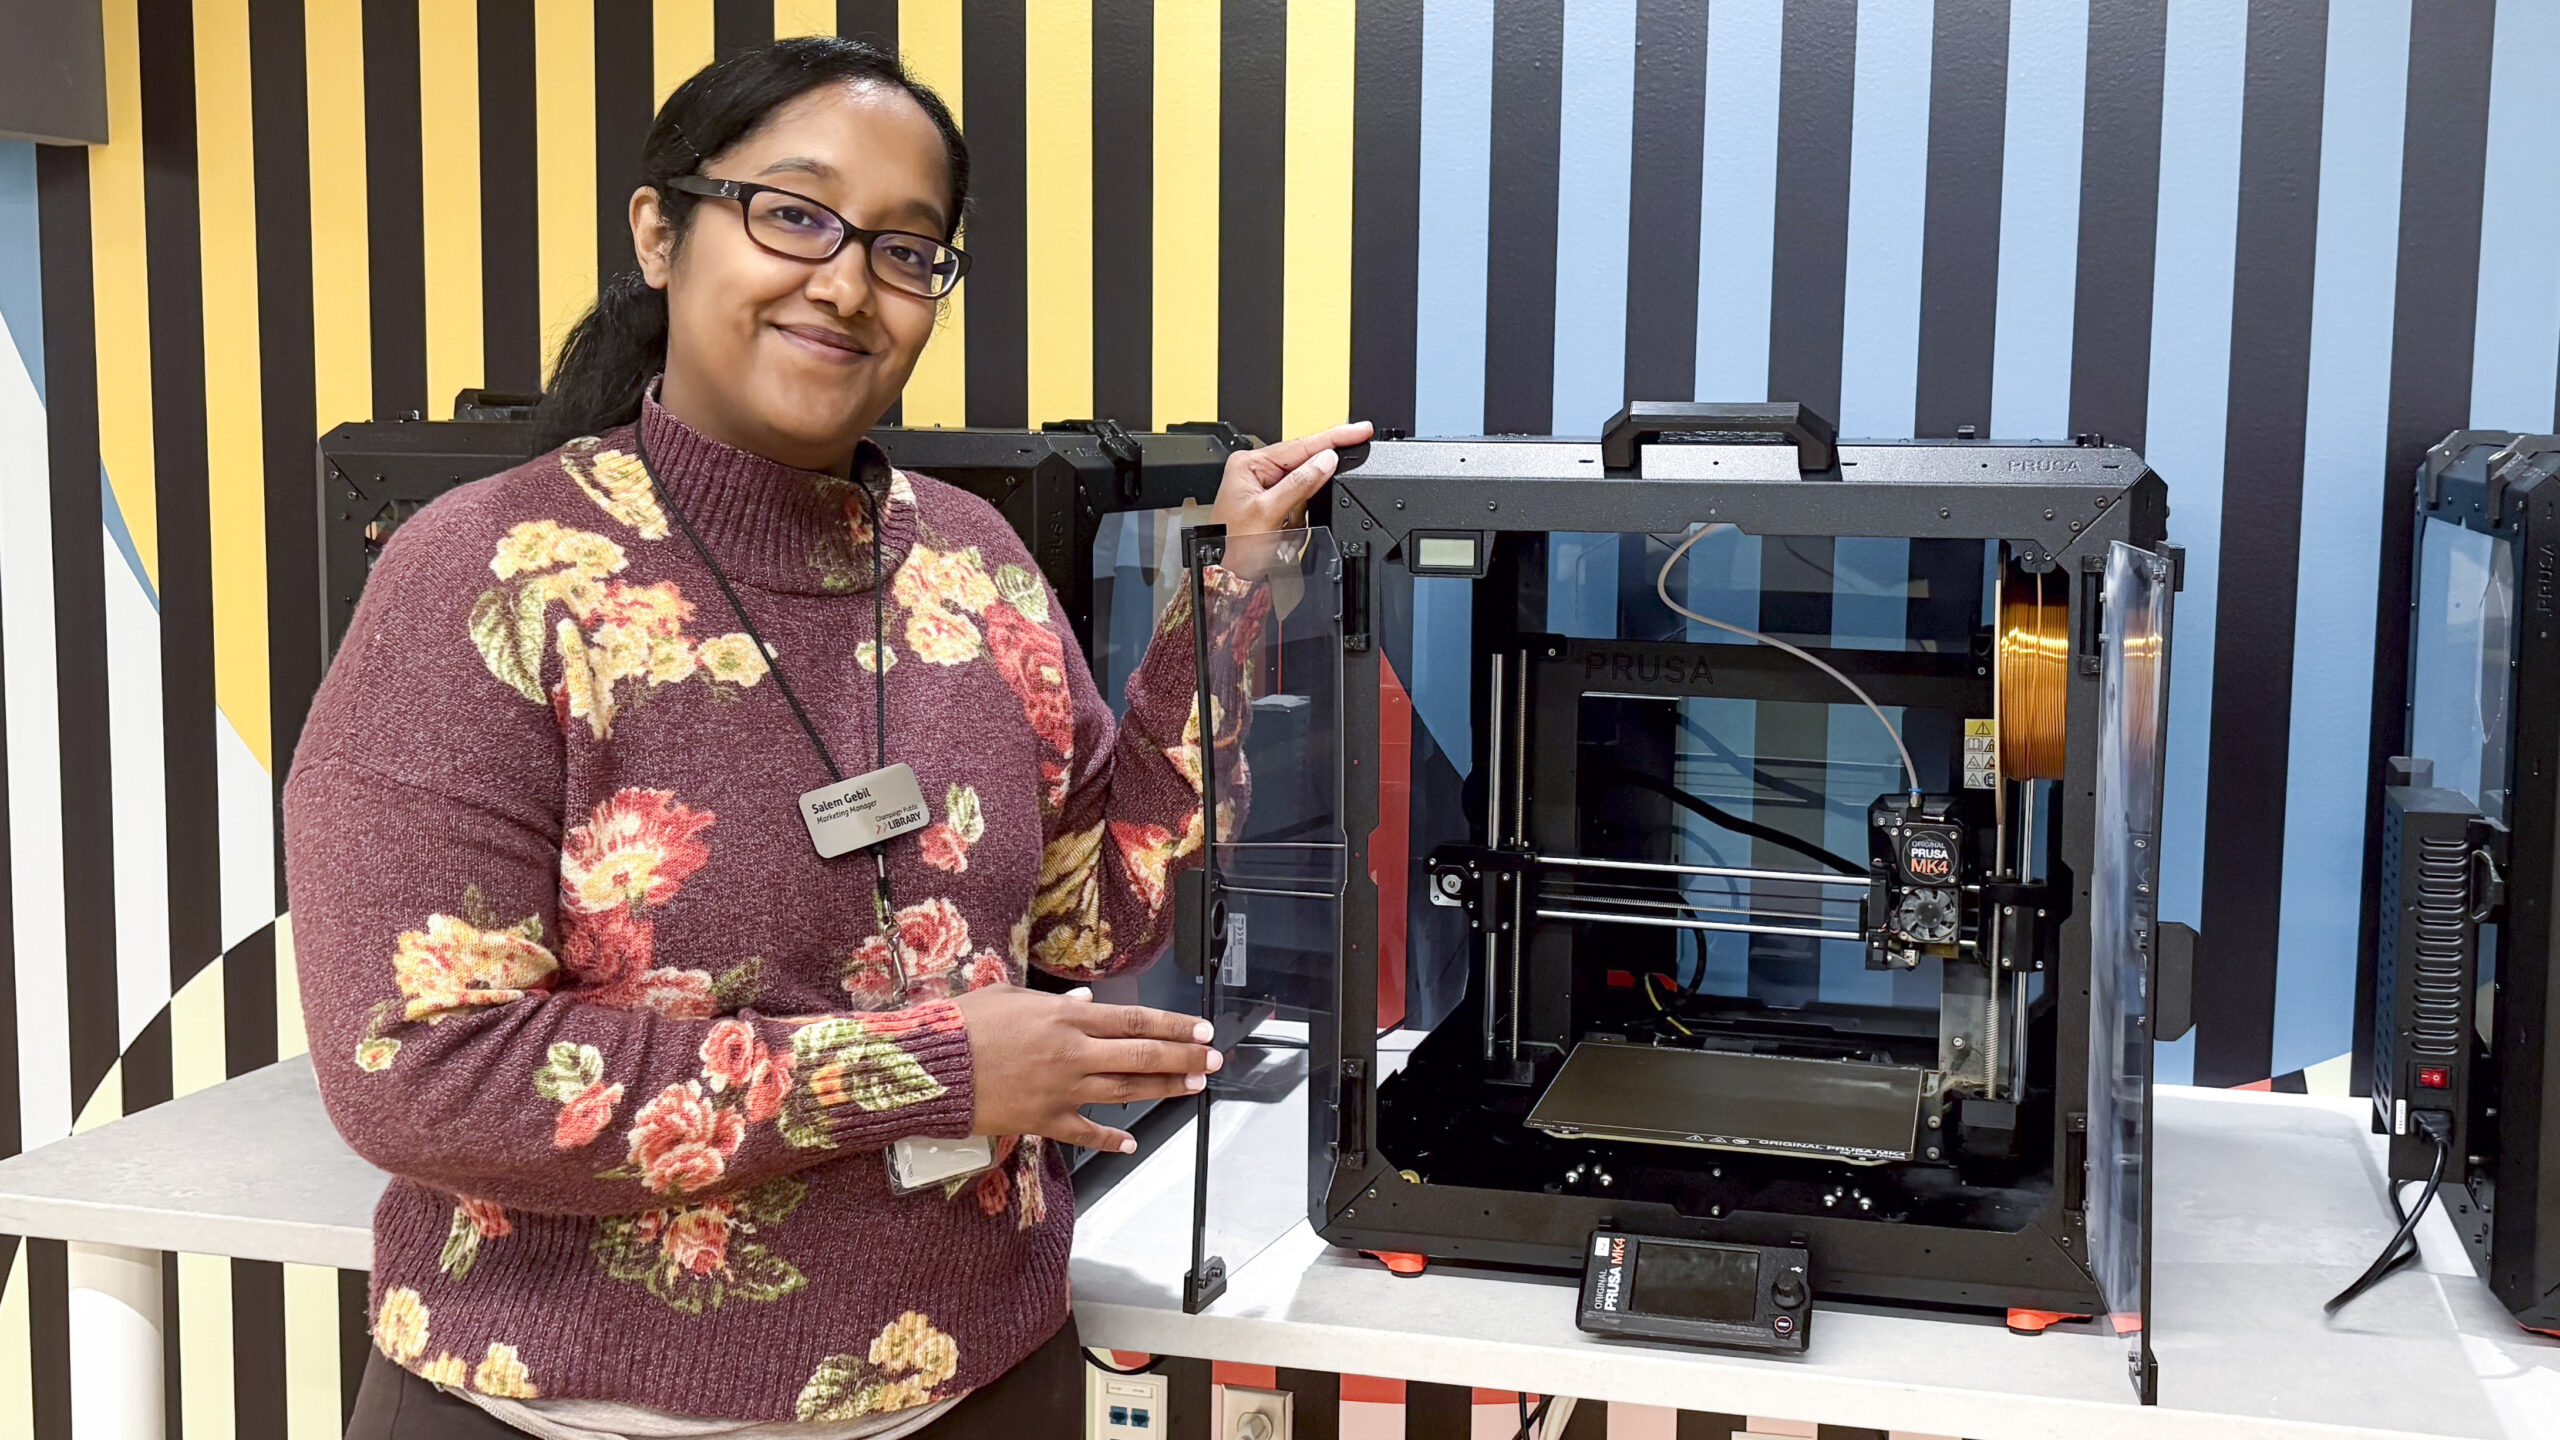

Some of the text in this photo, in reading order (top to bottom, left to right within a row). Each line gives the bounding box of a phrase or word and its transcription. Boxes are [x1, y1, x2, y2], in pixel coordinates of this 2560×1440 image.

[2008, 460, 2081, 472] PRUSA
[1585, 650, 1714, 685] PRUSA
[811, 787, 871, 814] Salem Gebil
[816, 800, 877, 824] Marketing Manager
[888, 811, 921, 830] LIBRARY
[1911, 840, 1946, 849] ORIGINAL
[1911, 848, 1949, 859] PRUSA
[1911, 858, 1949, 874] MK4
[1759, 1140, 1824, 1150] ORIGINAL
[1826, 1145, 1873, 1154] PRUSA
[1604, 1237, 1626, 1311] PRUSA MK4
[1594, 1269, 1608, 1309] ORIGINAL
